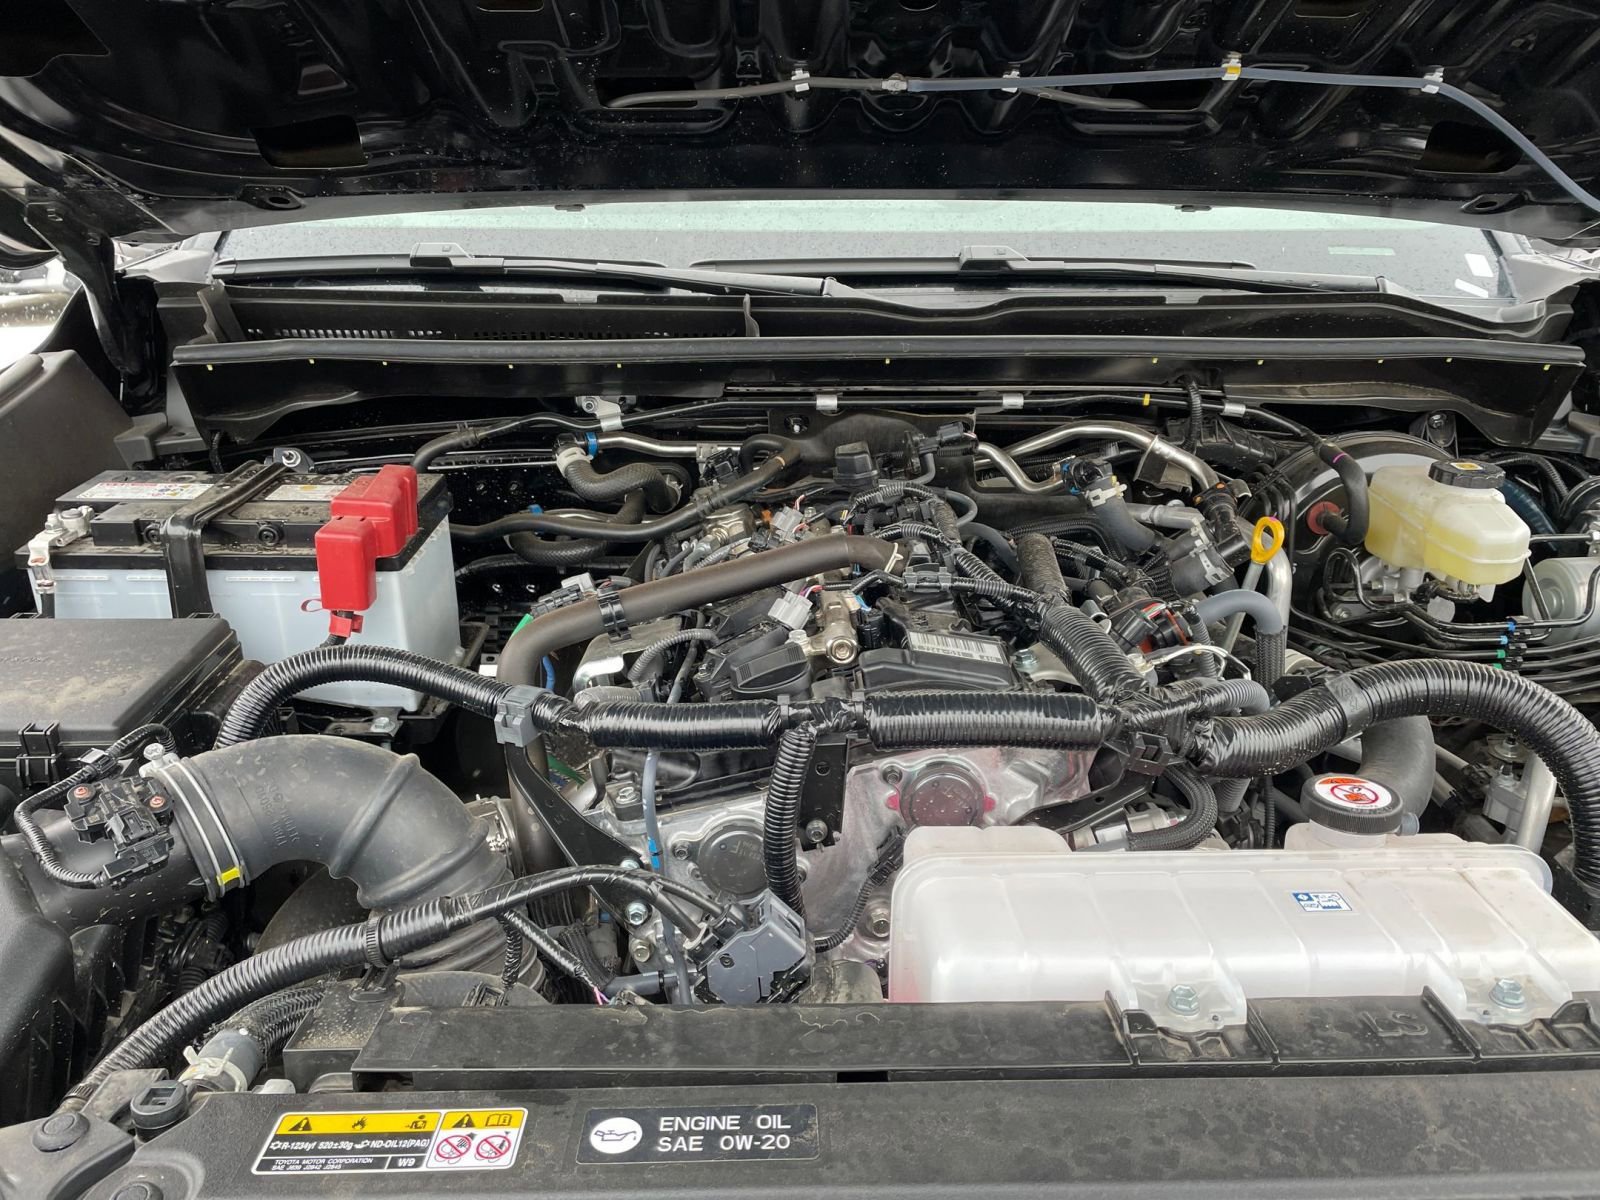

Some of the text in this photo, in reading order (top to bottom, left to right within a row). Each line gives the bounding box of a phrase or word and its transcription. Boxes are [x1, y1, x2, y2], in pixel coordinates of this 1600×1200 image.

[659, 1114, 791, 1132] ENGINE OIL
[281, 1141, 317, 1151] R-1234yf
[370, 1139, 430, 1148] ND-OIL12(PAG)
[657, 1134, 791, 1152] SAE 0W-20
[398, 1157, 416, 1167] W9
